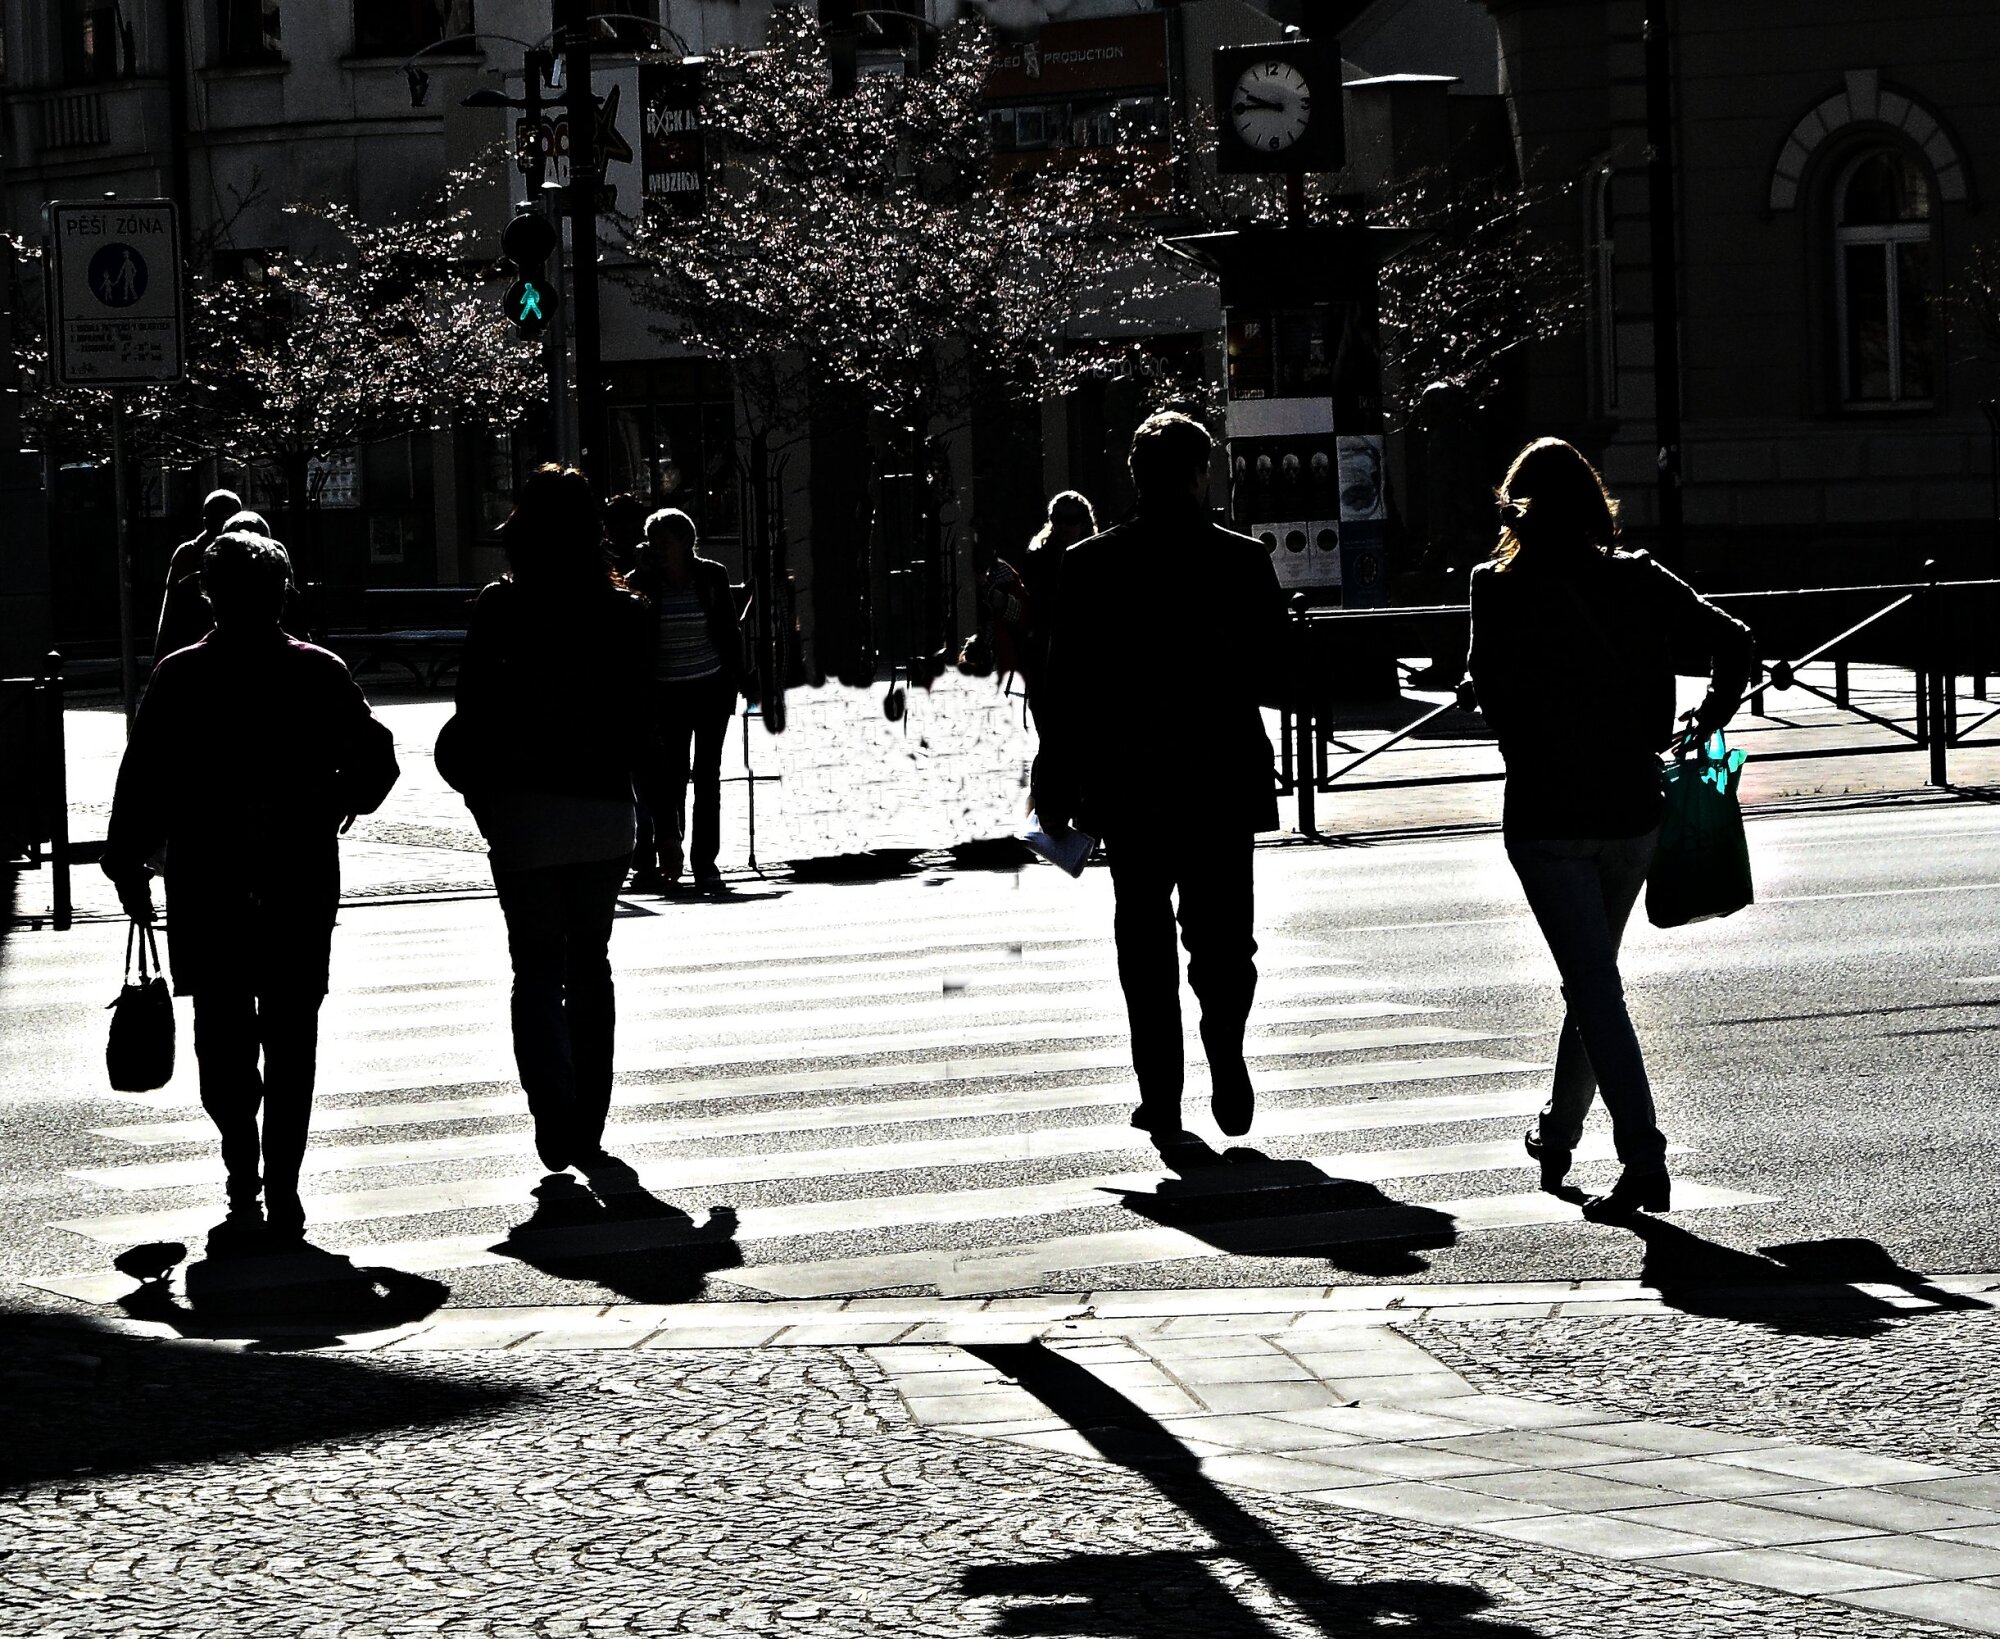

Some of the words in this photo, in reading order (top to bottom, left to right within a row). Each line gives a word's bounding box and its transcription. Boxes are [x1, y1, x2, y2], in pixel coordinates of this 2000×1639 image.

[1044, 45, 1124, 65] PRODUCTION
[1265, 63, 1279, 76] 12
[1301, 97, 1311, 110] 3
[1269, 136, 1280, 149] 6
[649, 169, 700, 193] MUZIKA
[67, 215, 107, 236] PĚŠÍ
[116, 214, 165, 235] ZÓNA
